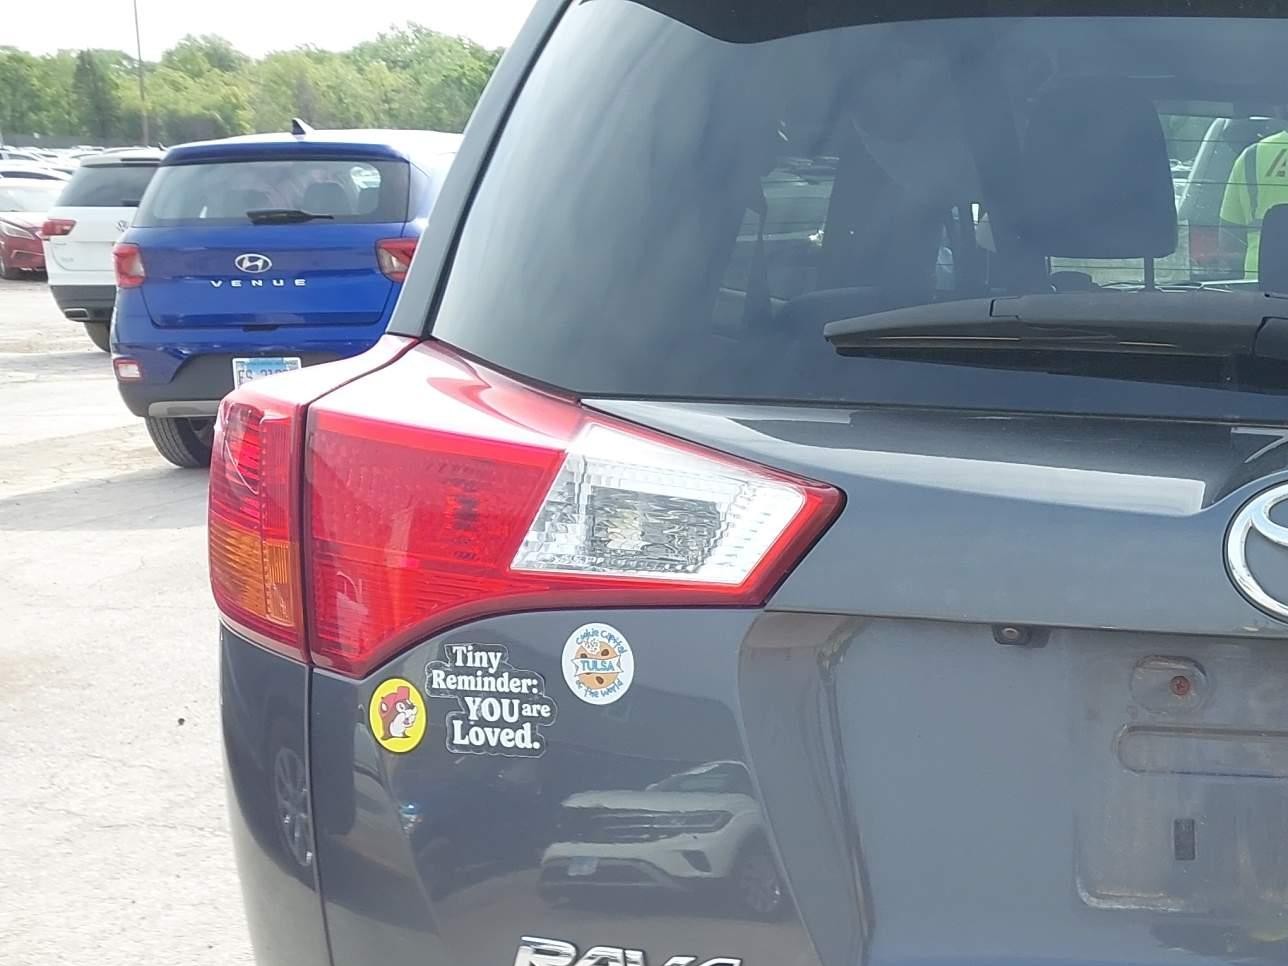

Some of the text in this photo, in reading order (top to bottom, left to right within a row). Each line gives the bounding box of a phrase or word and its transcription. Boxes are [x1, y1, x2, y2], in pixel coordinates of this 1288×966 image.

[210, 279, 306, 287] VENUE
[452, 646, 502, 671] Tiny
[580, 660, 615, 671] TULSA
[432, 669, 538, 694] Reminder:
[464, 697, 550, 722] YOU are
[452, 719, 540, 749] Loved.
